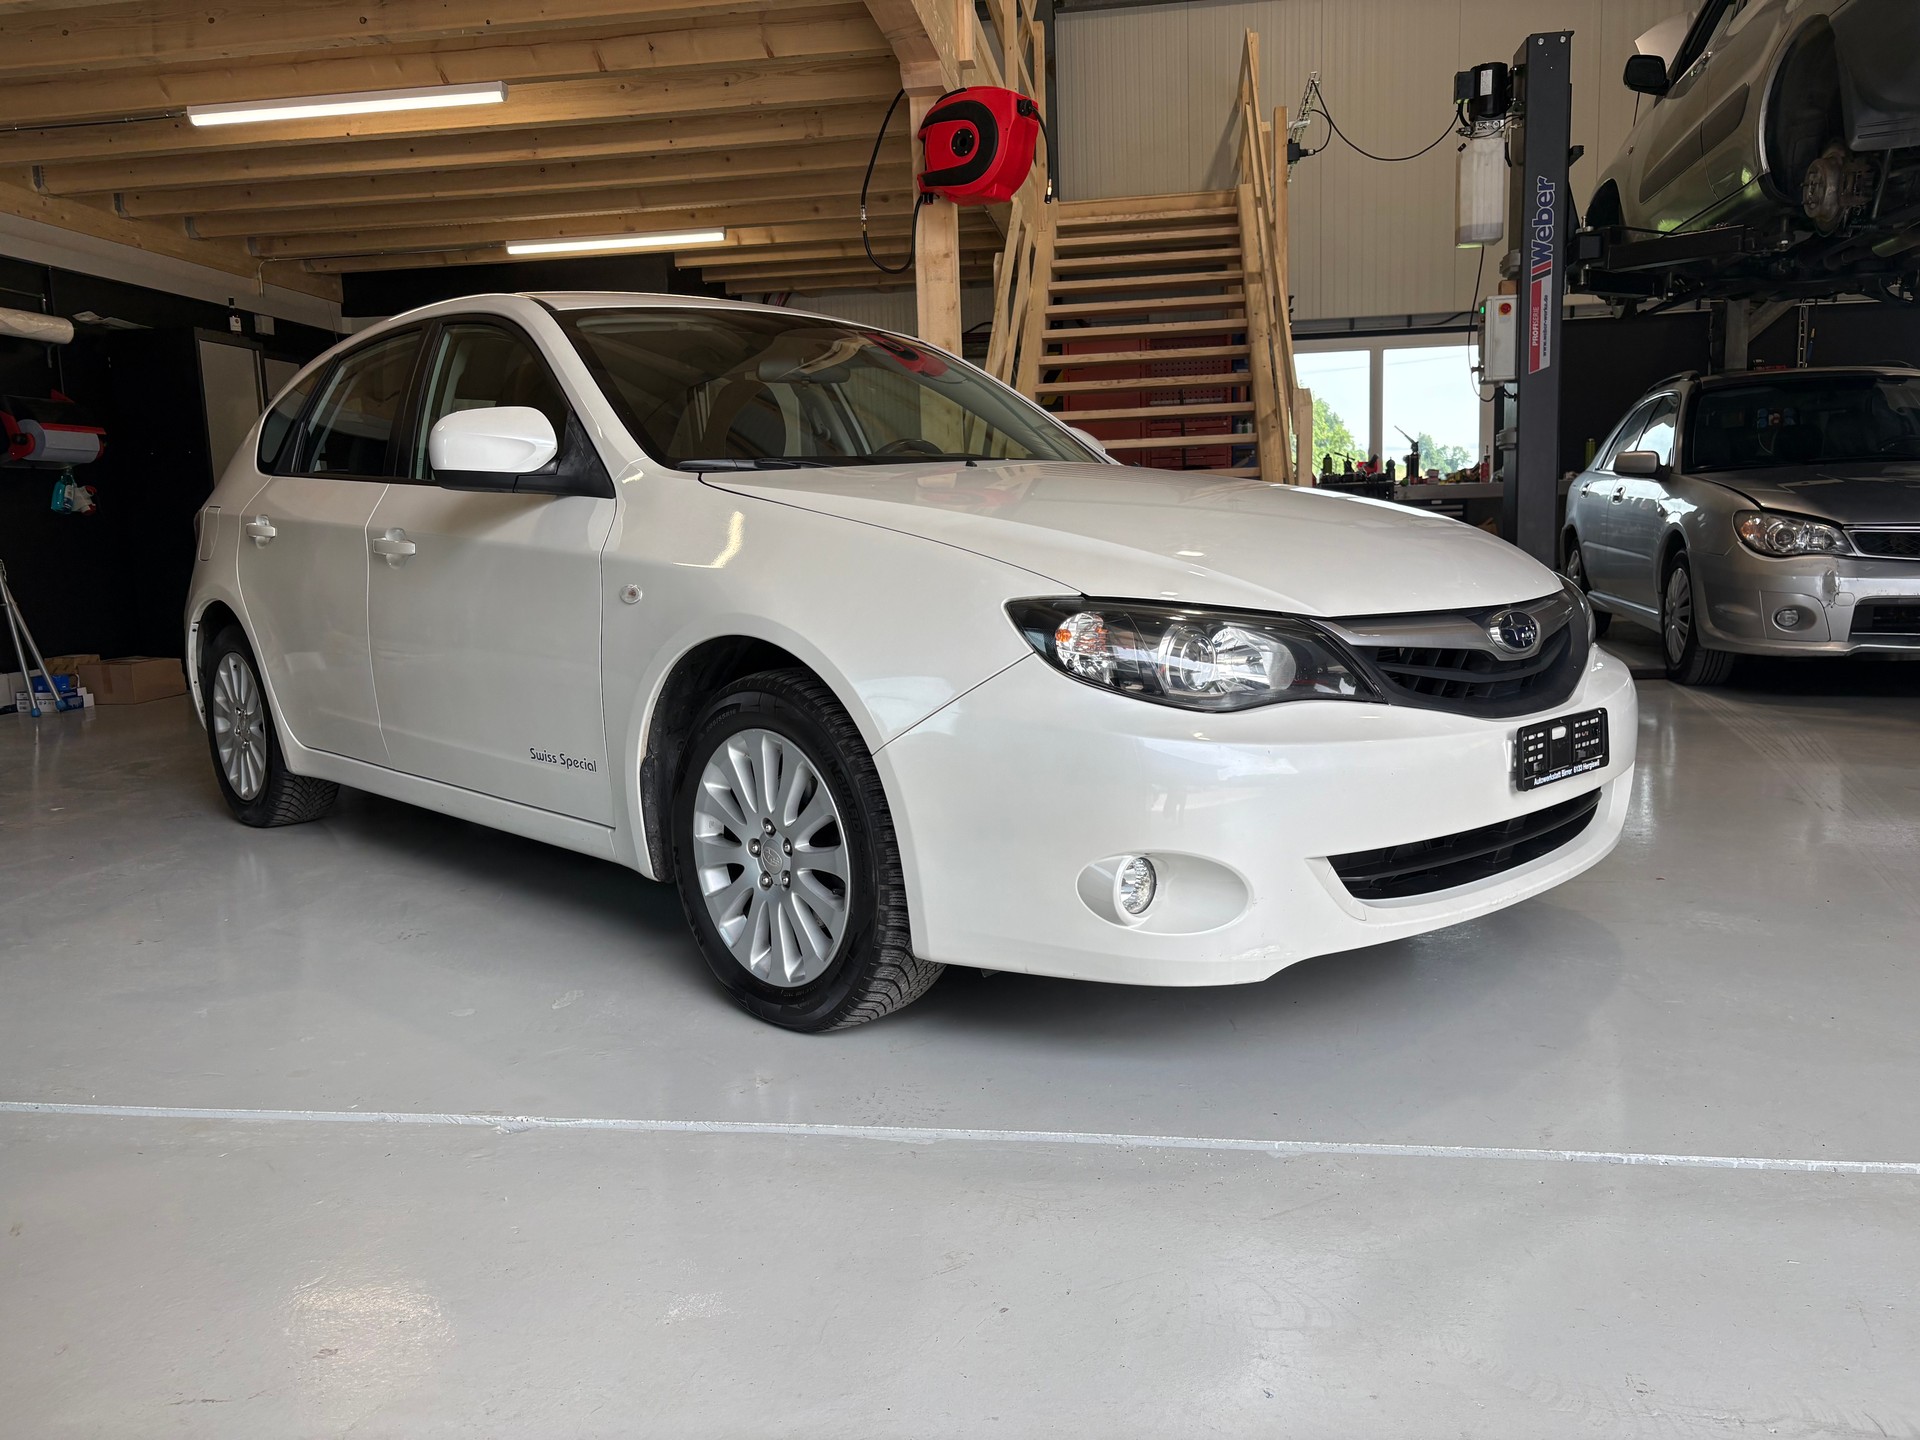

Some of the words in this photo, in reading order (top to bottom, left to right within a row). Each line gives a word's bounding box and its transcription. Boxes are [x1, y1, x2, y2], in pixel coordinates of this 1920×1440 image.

[1531, 175, 1555, 265] Weber
[1532, 306, 1540, 346] PROFISERIE
[529, 747, 557, 763] Swiss
[559, 753, 597, 772] Special
